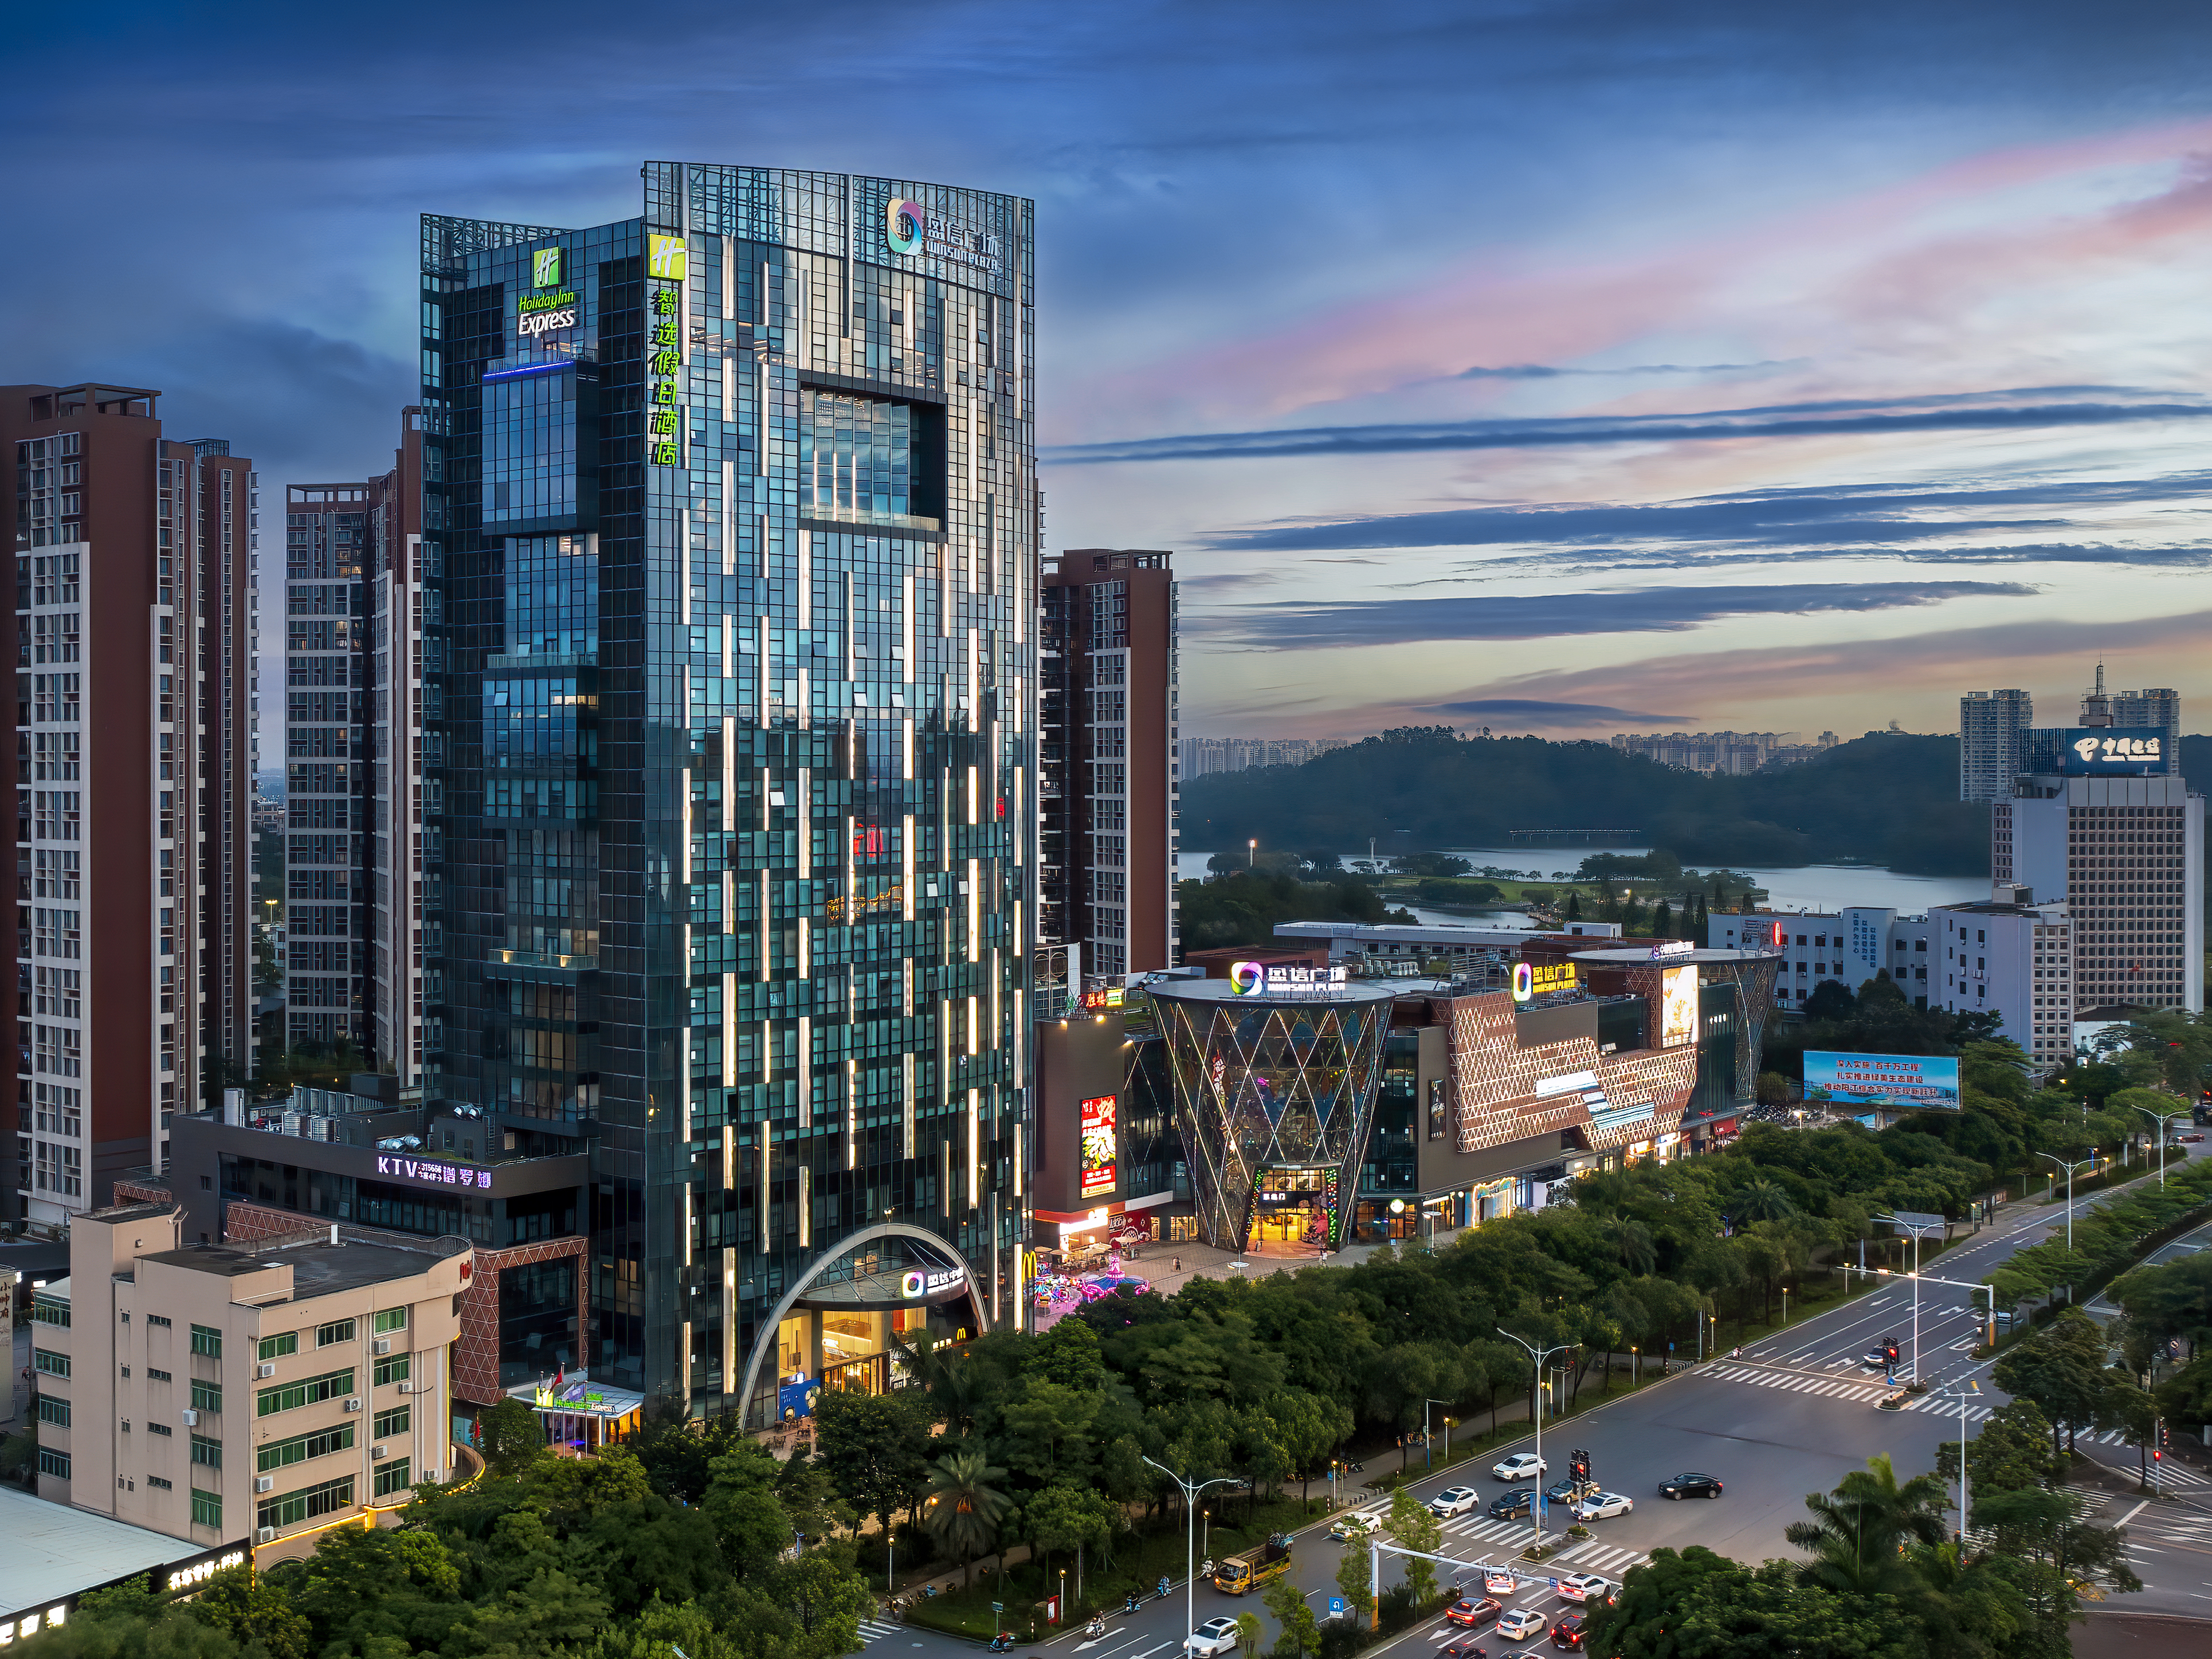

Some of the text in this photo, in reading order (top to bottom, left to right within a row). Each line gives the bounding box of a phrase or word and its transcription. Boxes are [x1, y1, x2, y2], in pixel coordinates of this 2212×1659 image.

[926, 215, 997, 256] 盈信广场
[518, 309, 575, 338] Express
[656, 289, 680, 465] 智选假日酒店
[1268, 966, 1346, 982] 盈信广场
[1533, 963, 1575, 983] 盈信广场
[378, 1156, 418, 1178] KTV
